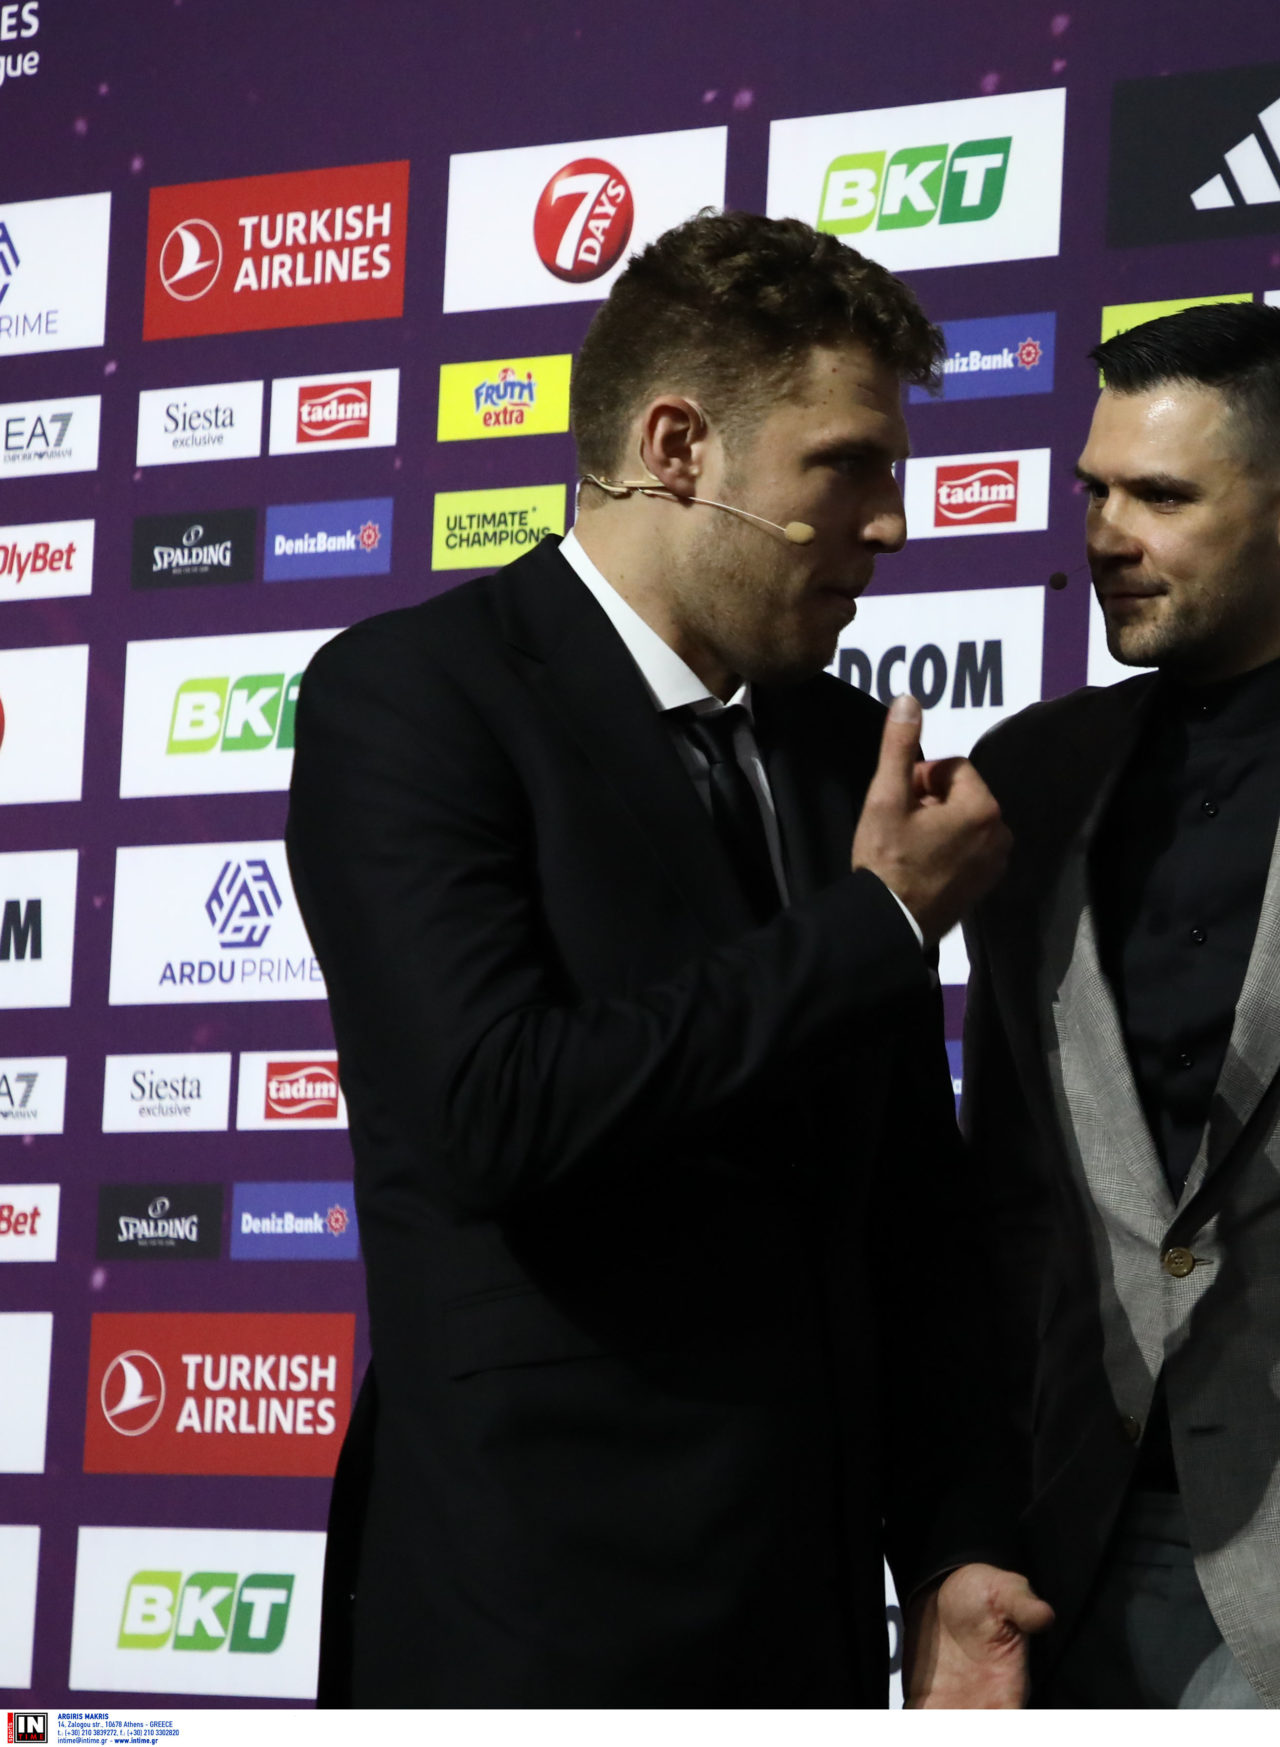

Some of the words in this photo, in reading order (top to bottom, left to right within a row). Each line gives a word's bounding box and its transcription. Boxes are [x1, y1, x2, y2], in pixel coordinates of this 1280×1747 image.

[820, 150, 1006, 224] BKT
[238, 202, 391, 251] TURKISH
[550, 172, 611, 271] 7
[577, 179, 625, 266] DAYS
[233, 243, 391, 293] AIRLINES
[943, 348, 1015, 374] nizBank
[5, 411, 73, 450] EA7
[163, 402, 235, 434] Siesta
[483, 406, 525, 427] extra
[172, 432, 224, 449] exclusive
[446, 511, 528, 531] ULTIMATE
[152, 540, 232, 572] SPALDING
[274, 526, 356, 556] DenizBank
[838, 639, 1004, 710] DCOM
[130, 1070, 202, 1101] Siesta
[139, 1102, 191, 1117] exclusive
[118, 1214, 198, 1242] SPALDING
[241, 1212, 324, 1235] DenizBank
[181, 1354, 337, 1392] TURKISH
[175, 1397, 336, 1435] AIRLINES
[122, 1583, 290, 1640] BKT
